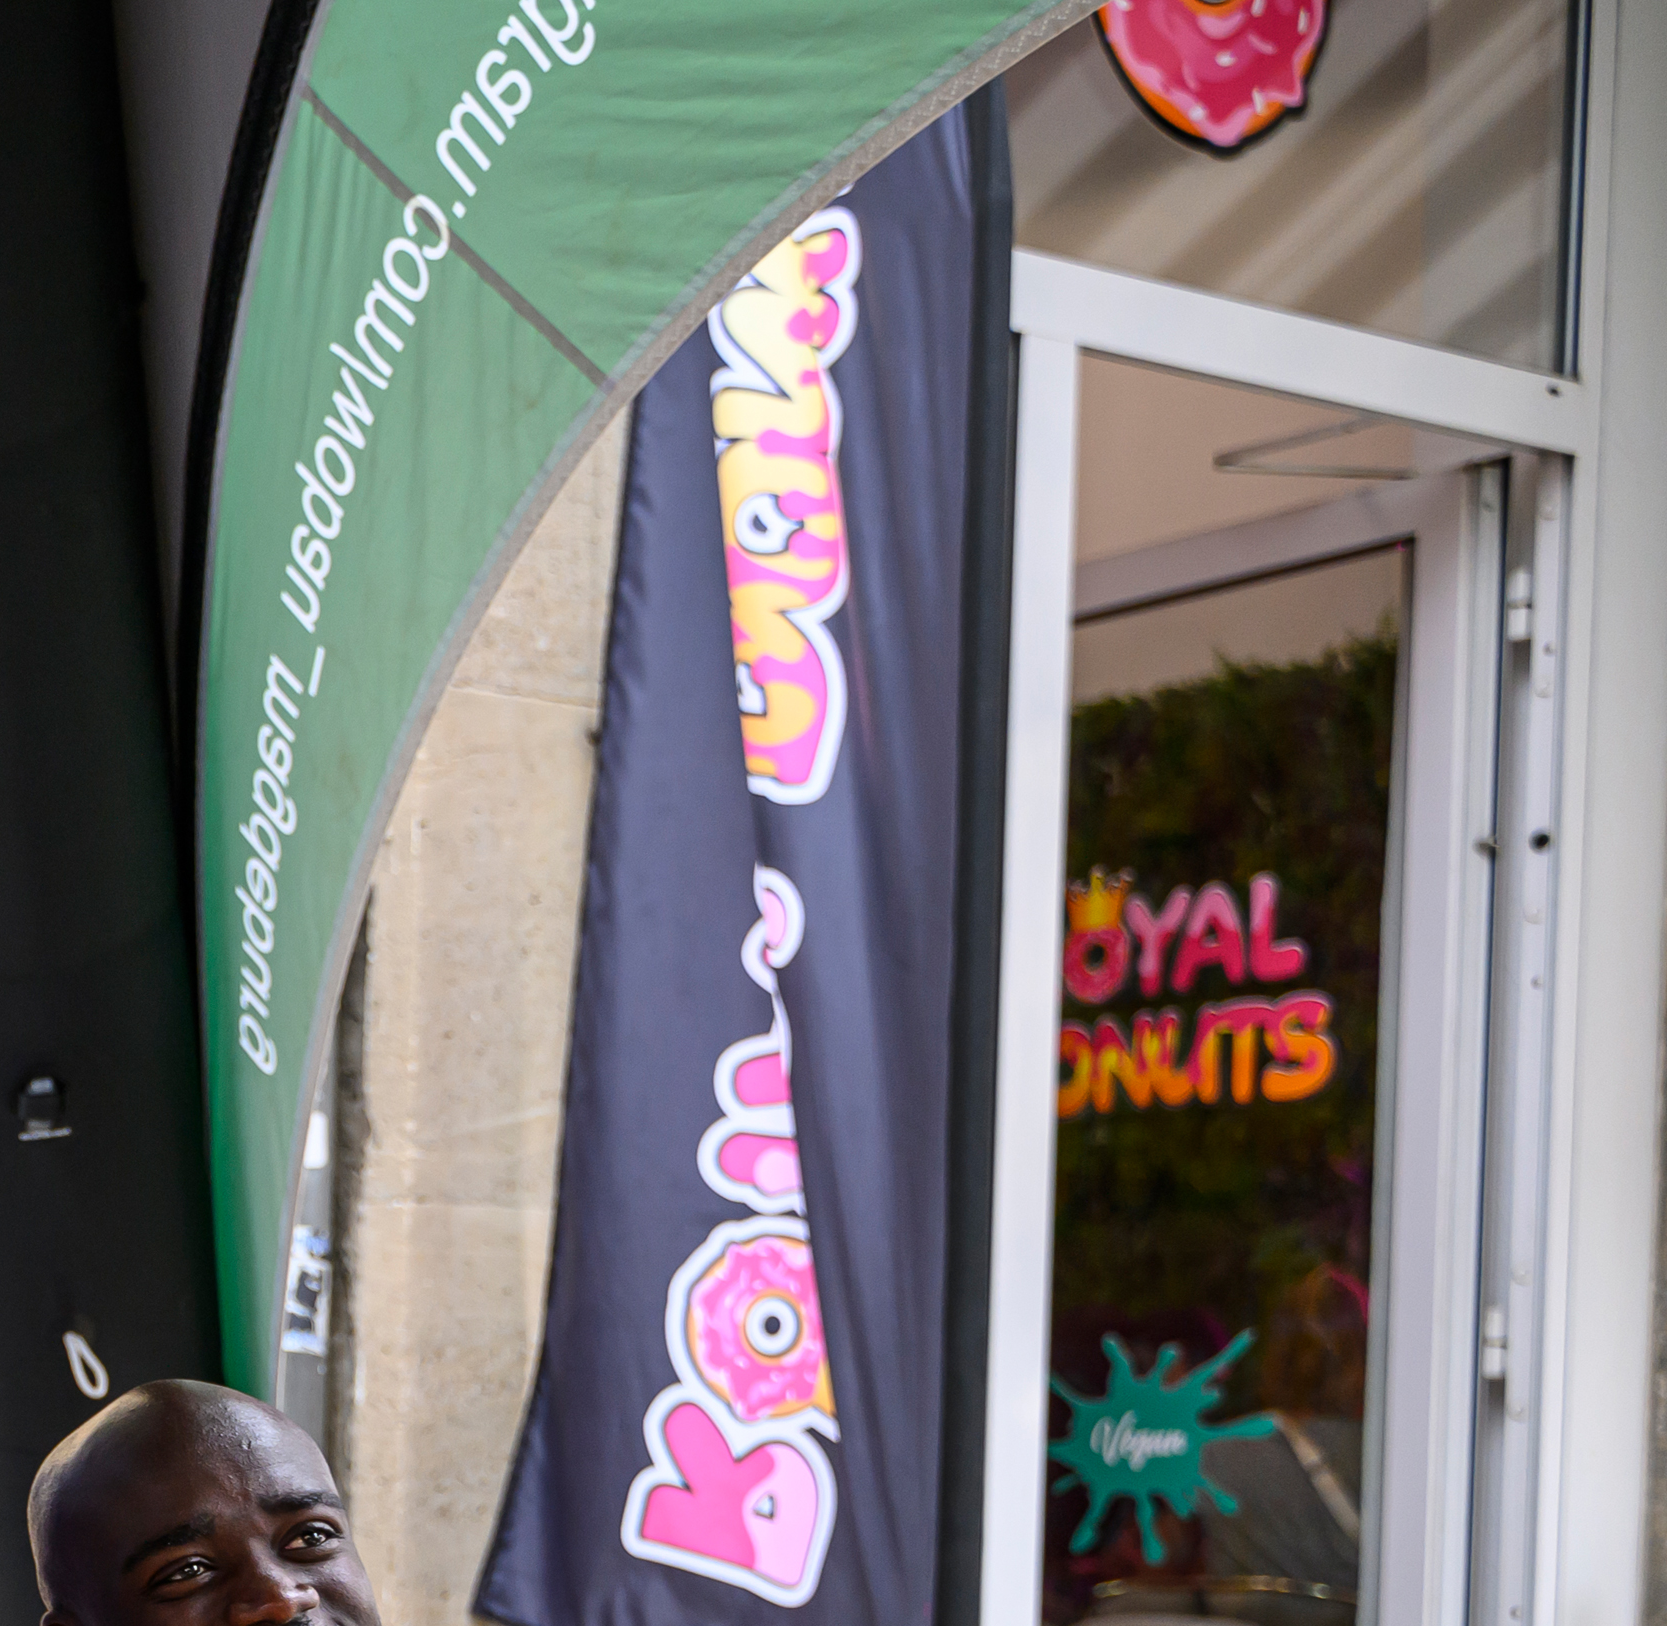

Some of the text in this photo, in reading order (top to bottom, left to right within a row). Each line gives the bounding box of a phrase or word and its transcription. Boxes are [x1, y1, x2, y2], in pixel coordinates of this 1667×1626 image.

[1063, 878, 1306, 1005] OYAL
[1058, 992, 1335, 1118] ONUTS
[1089, 1409, 1189, 1473] Vegan
